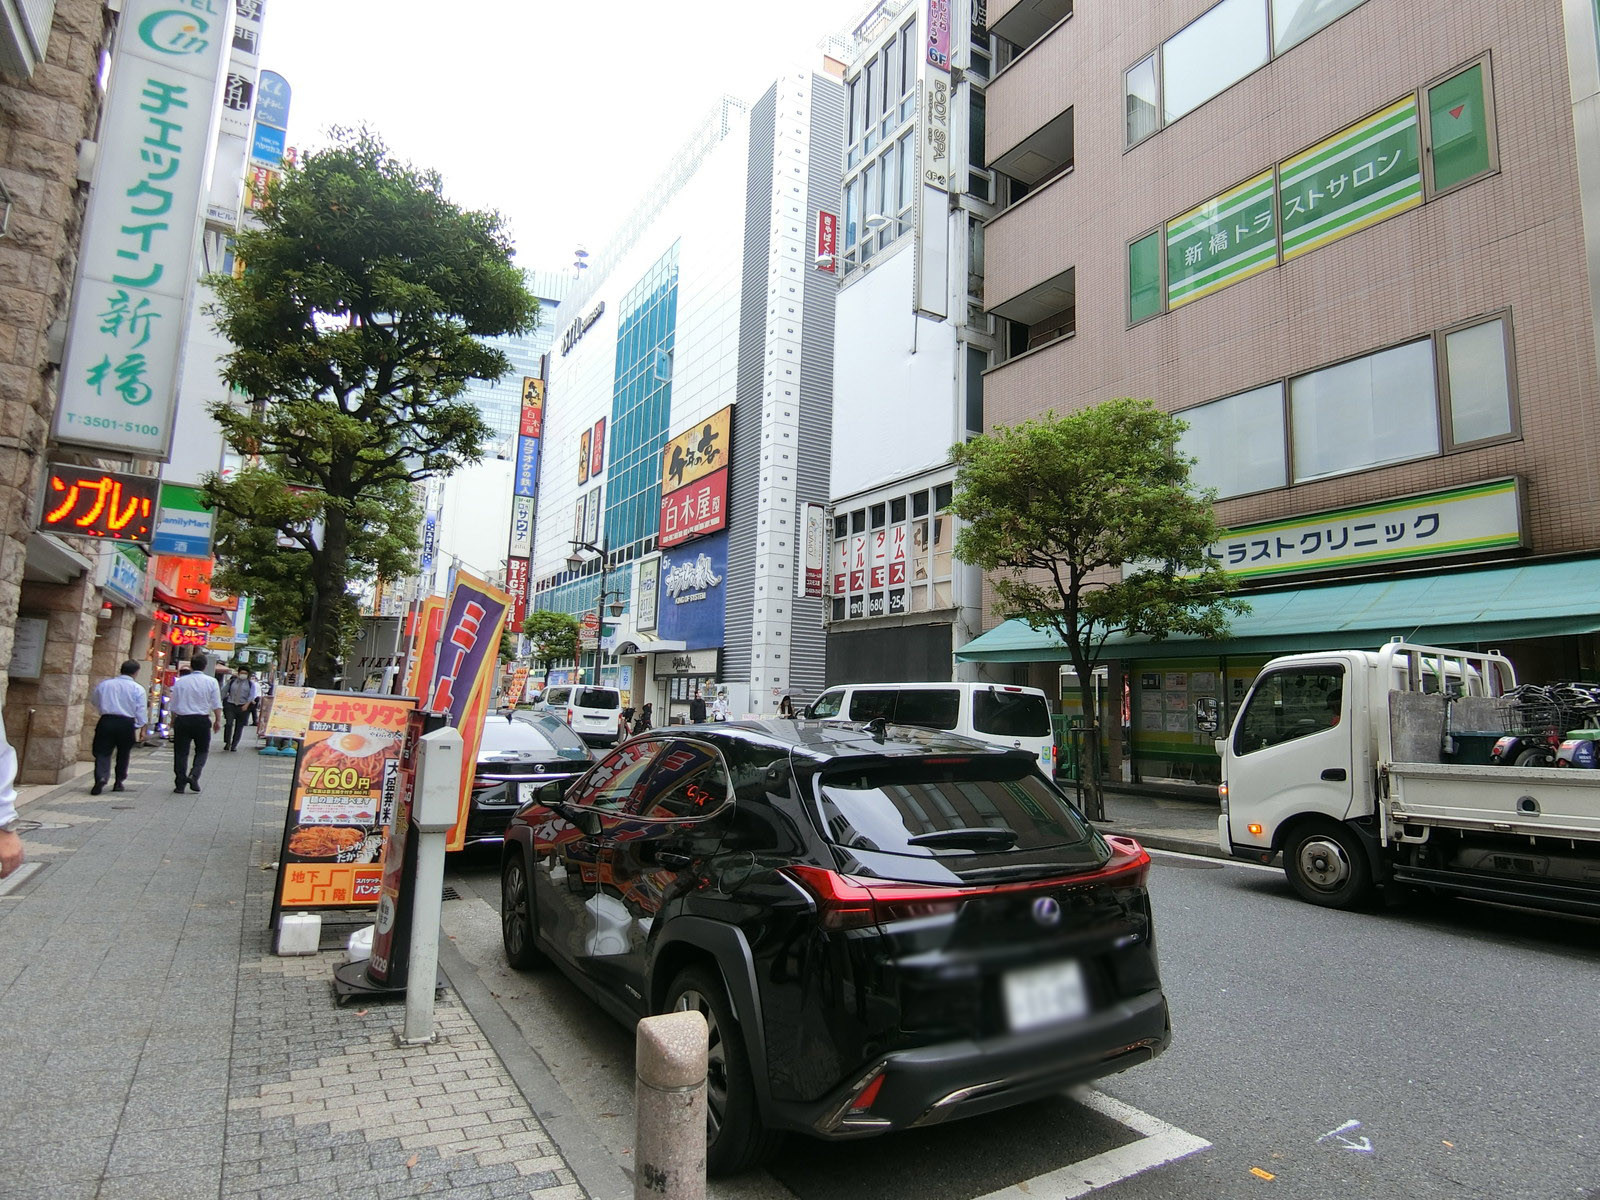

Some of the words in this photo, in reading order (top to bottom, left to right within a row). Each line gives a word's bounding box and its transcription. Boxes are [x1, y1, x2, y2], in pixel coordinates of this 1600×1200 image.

[930, 48, 947, 65] 6F
[935, 80, 947, 126] BODY
[934, 129, 946, 162] SPA
[1184, 149, 1401, 267] 新橋トラストサロン
[66, 412, 160, 436] T:3501-5100
[163, 516, 210, 530] amilyMart
[517, 510, 529, 541] サウナ
[312, 700, 407, 726] ナポリタン
[307, 766, 371, 790] 760円
[291, 870, 320, 883] 地下
